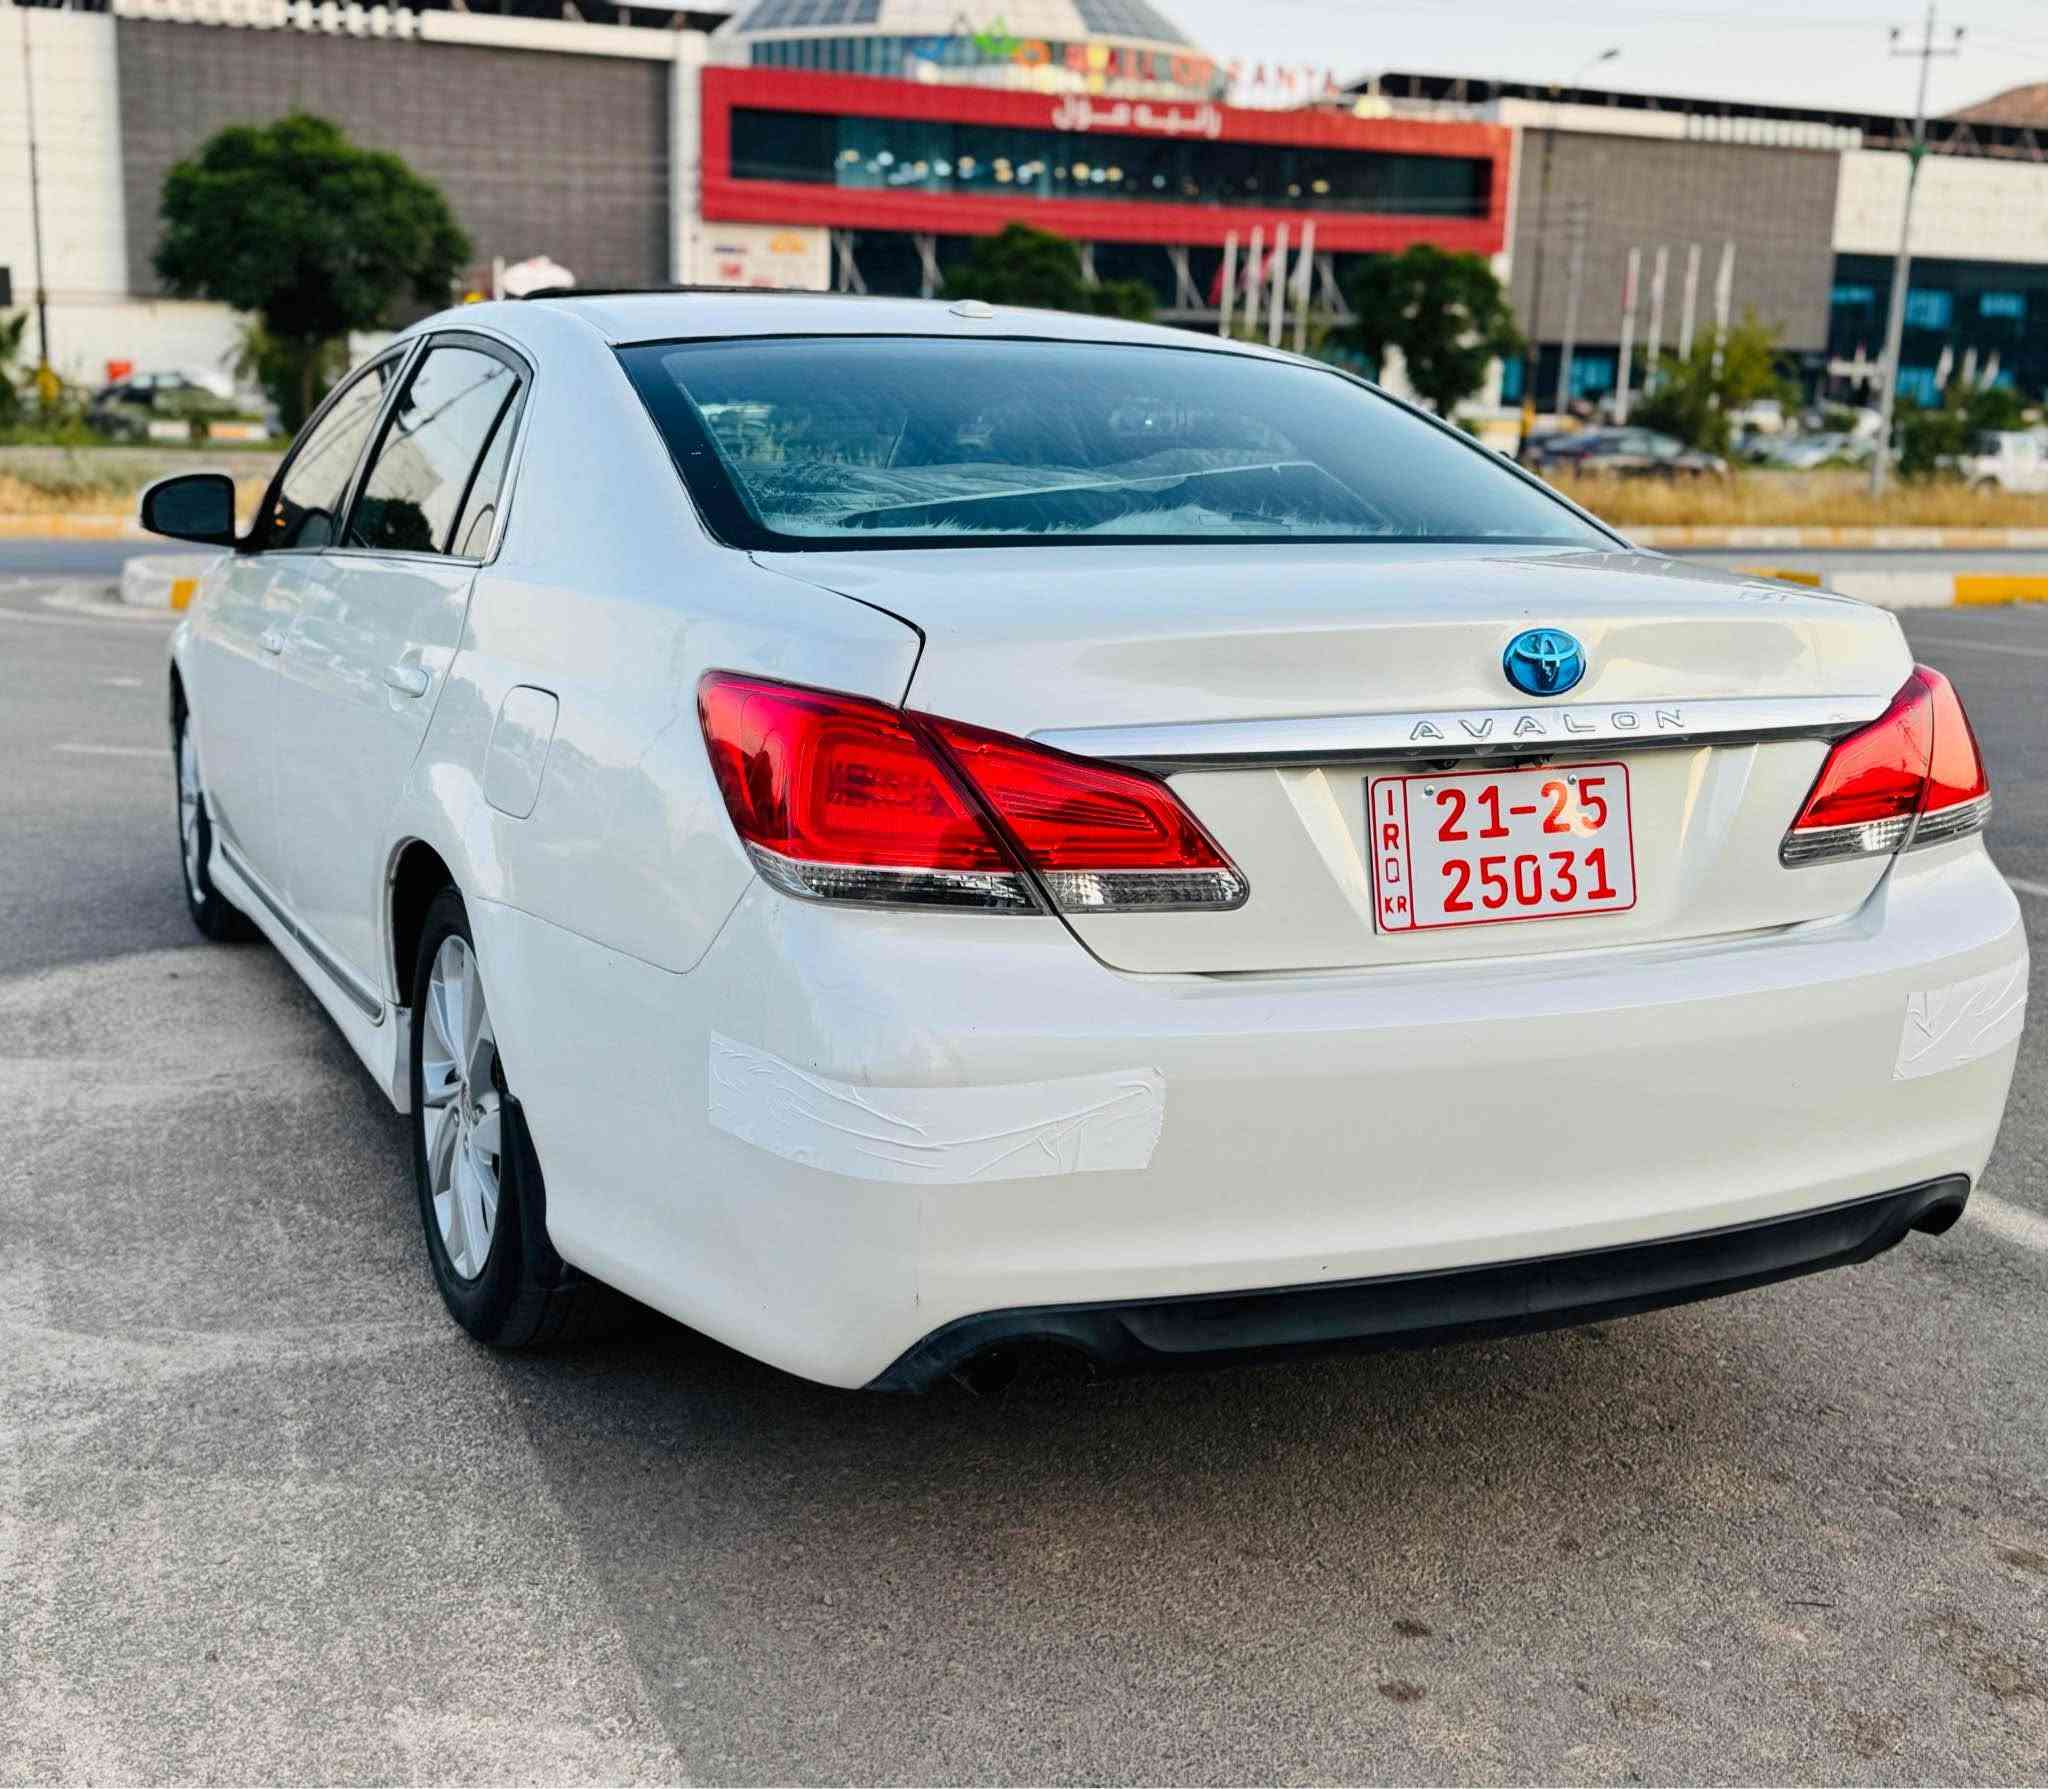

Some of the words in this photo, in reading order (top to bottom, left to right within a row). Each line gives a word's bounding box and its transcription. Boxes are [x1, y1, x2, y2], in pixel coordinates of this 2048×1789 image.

[1409, 708, 1687, 741] AVALON
[1435, 777, 1609, 843] 21-25
[1384, 895, 1408, 914] KR
[1441, 847, 1617, 913] 25031
